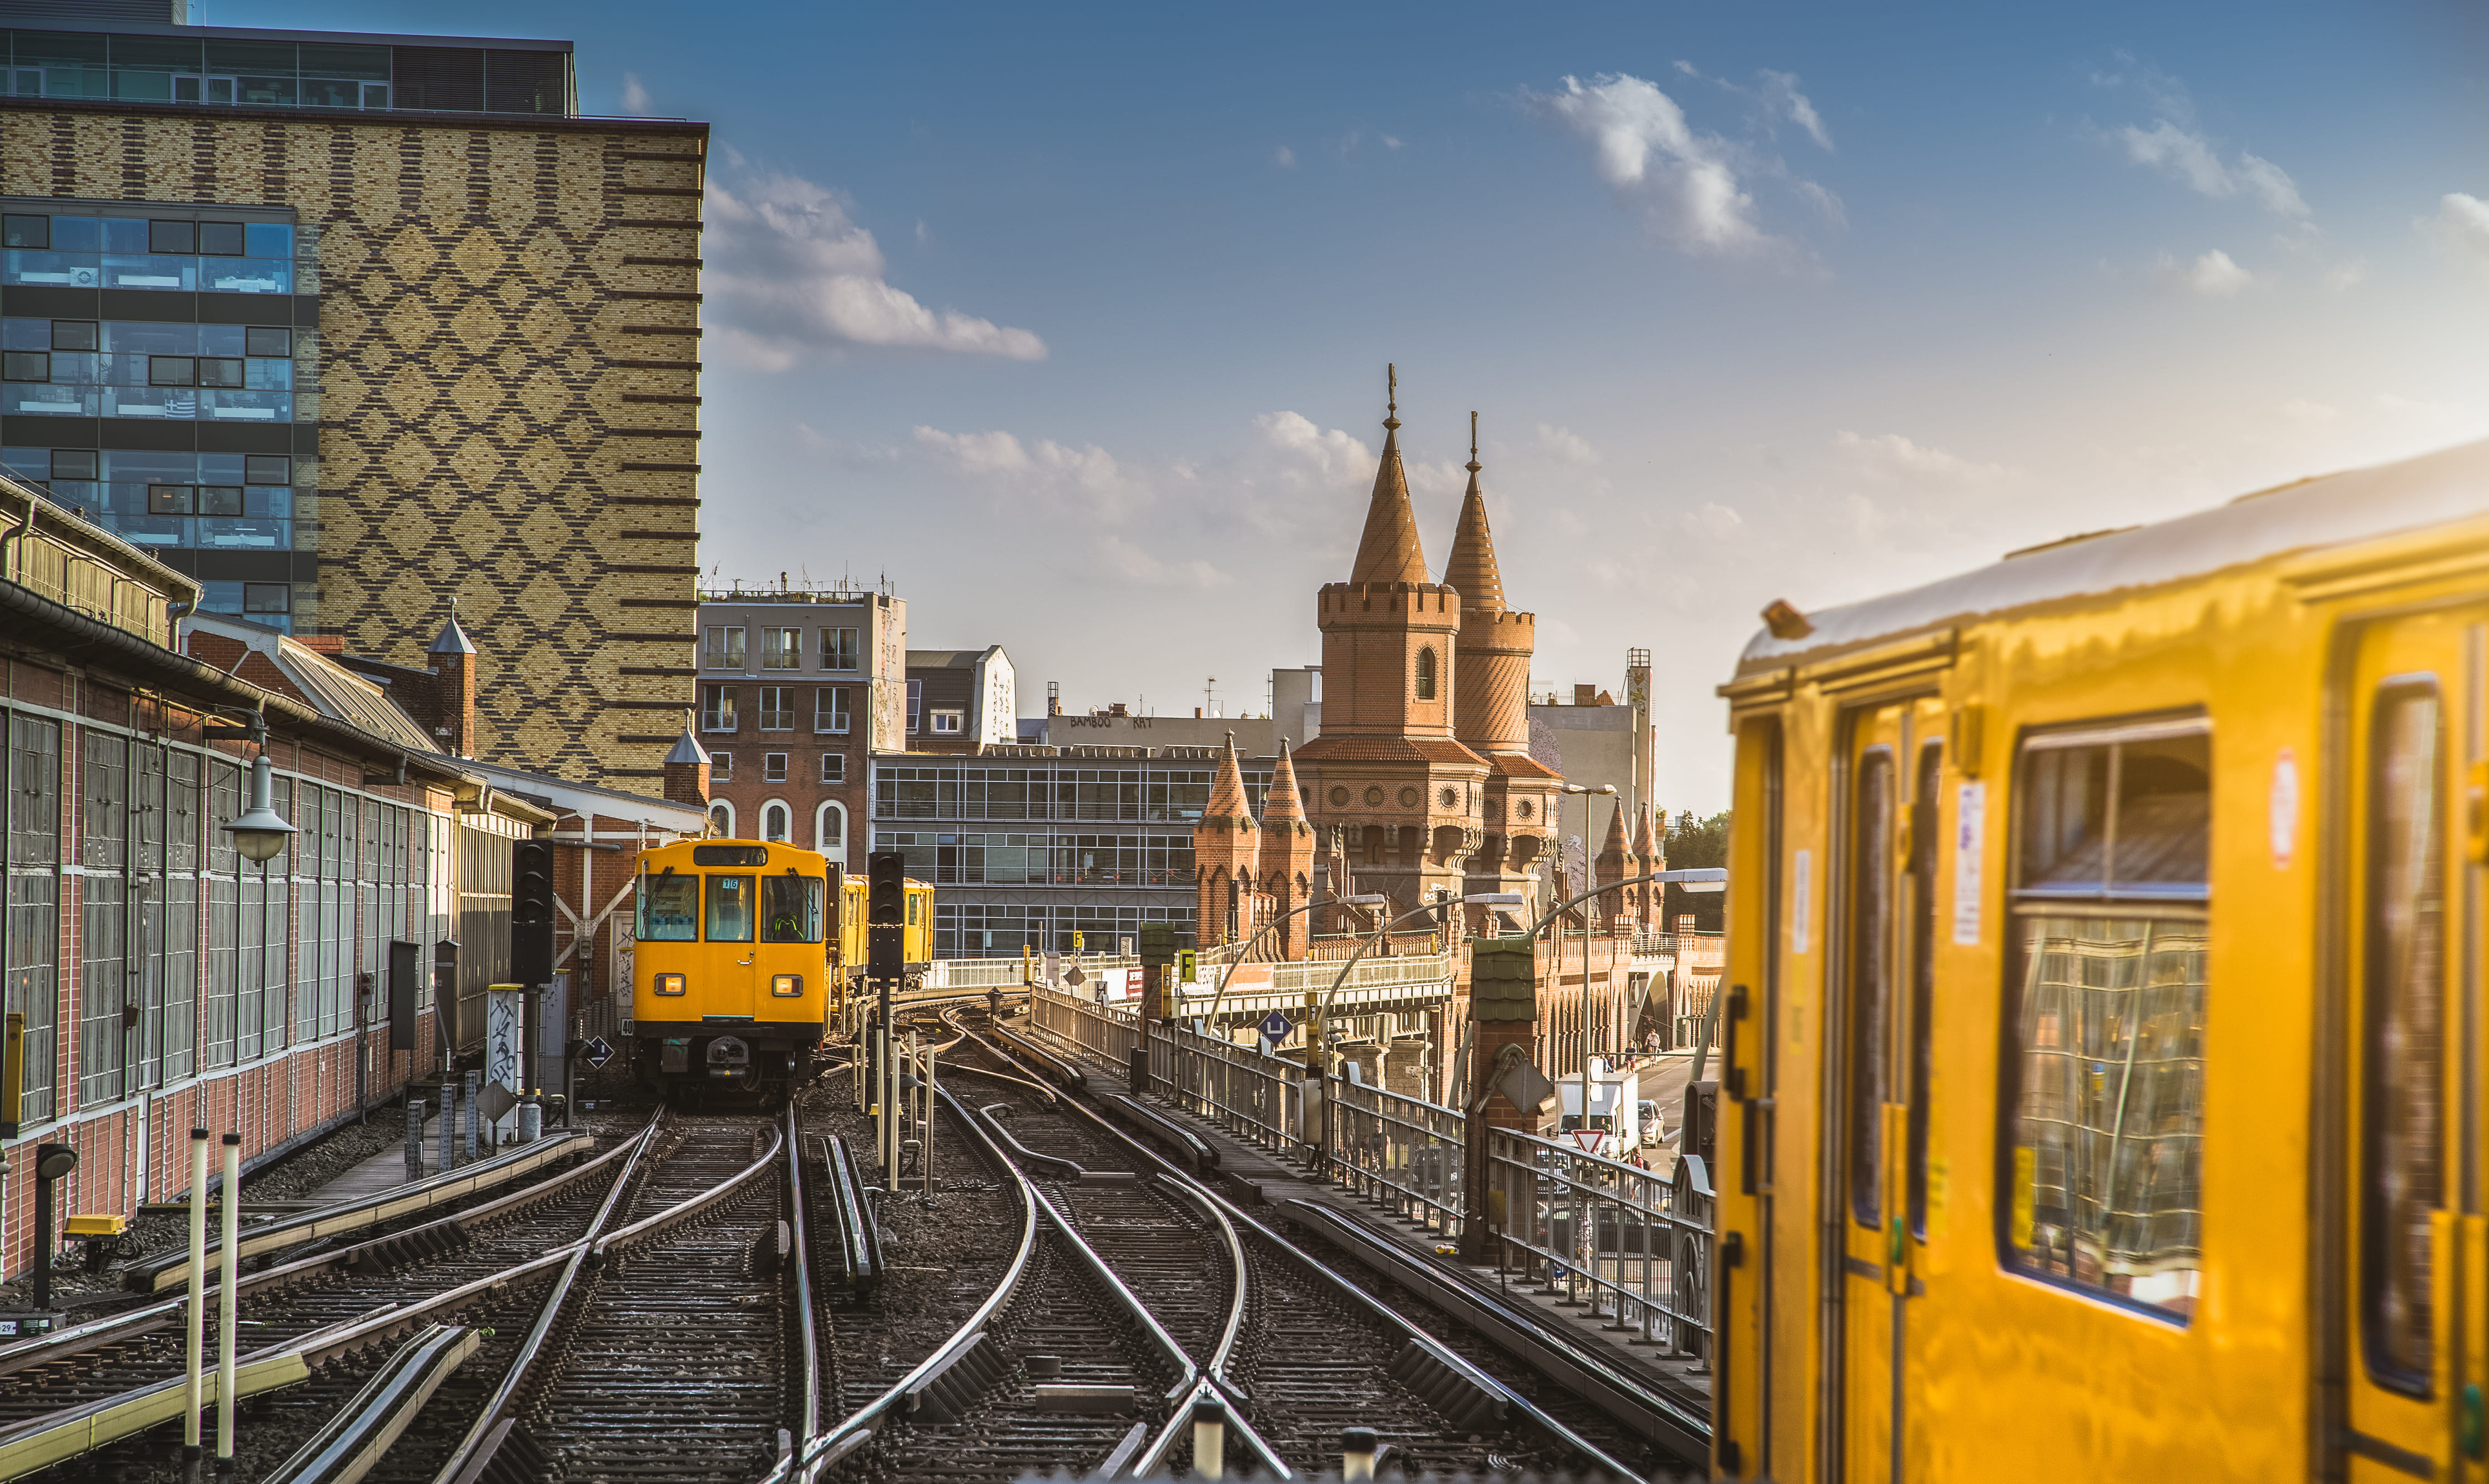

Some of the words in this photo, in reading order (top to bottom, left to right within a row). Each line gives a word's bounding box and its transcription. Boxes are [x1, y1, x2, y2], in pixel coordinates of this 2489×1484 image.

[1070, 716, 1111, 728] BAMBOO
[1133, 717, 1153, 729] RAT
[1076, 932, 1081, 945] F
[1182, 953, 1194, 978] F
[623, 1020, 633, 1034] 40
